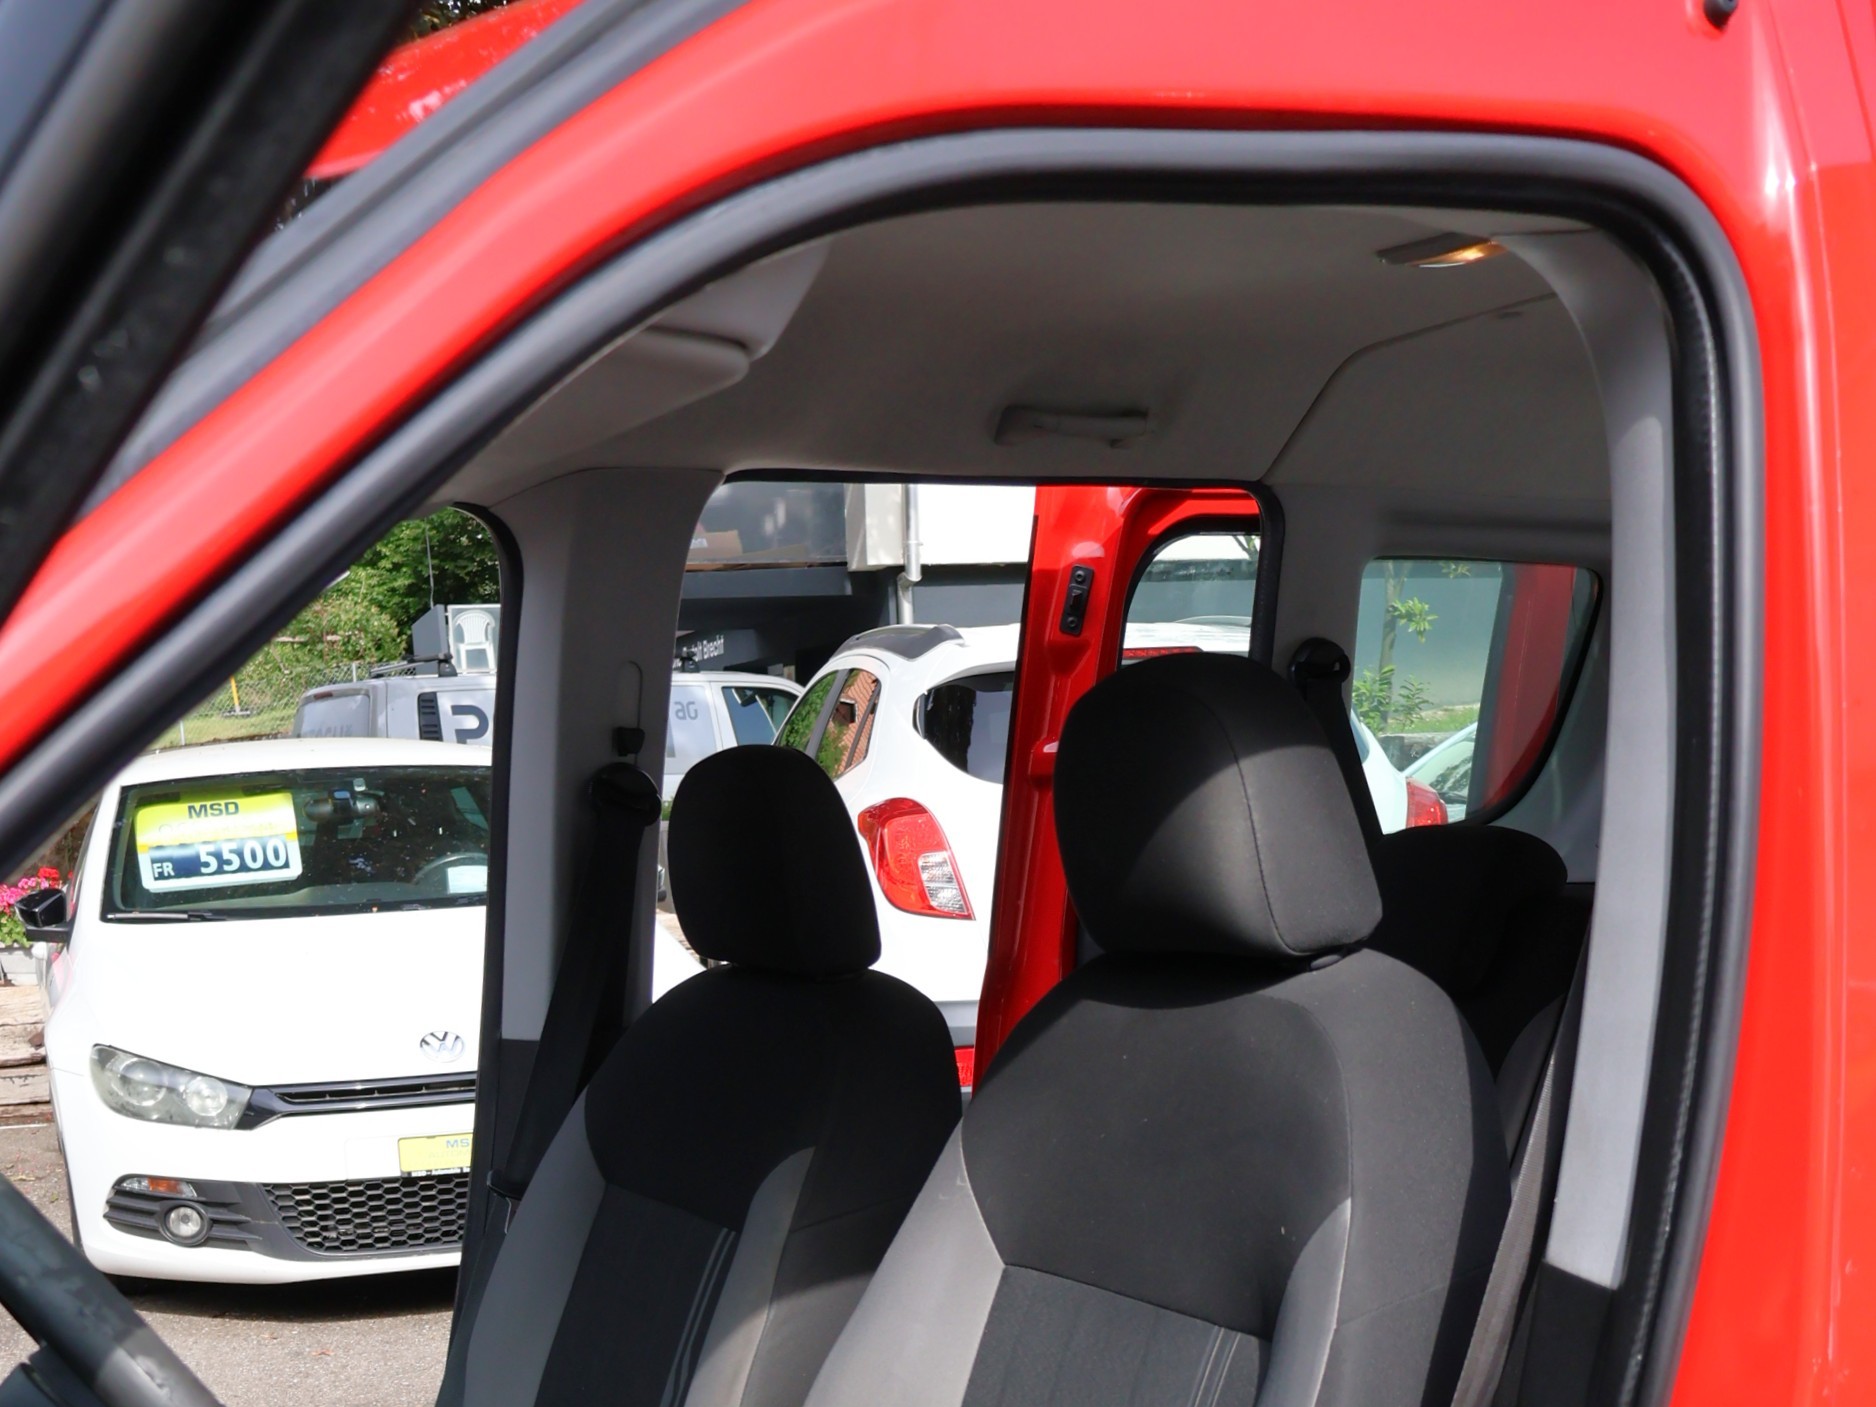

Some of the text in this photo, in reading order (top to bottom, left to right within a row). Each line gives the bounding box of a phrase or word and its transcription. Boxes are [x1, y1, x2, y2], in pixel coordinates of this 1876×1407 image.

[188, 801, 239, 818] MSD
[152, 838, 287, 878] FR 5500
